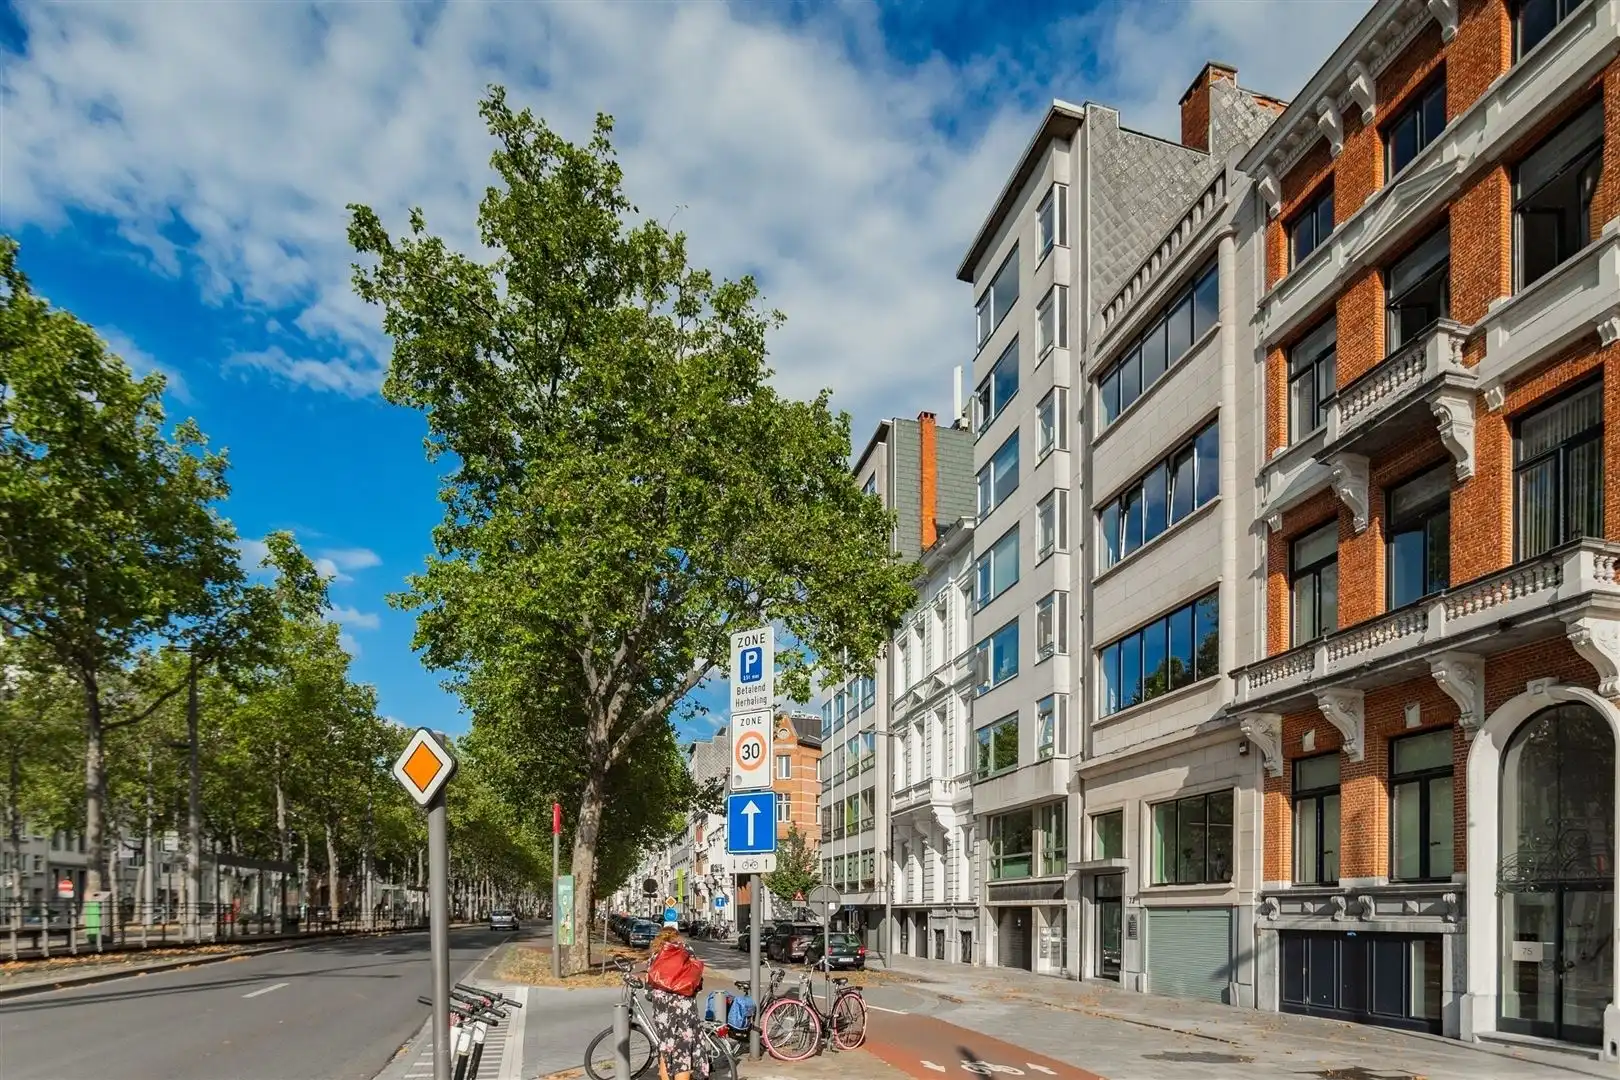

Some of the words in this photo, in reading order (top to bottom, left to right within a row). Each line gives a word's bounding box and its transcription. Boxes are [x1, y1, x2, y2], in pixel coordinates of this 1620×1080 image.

[737, 632, 766, 648] ZONE
[745, 651, 758, 674] P
[736, 683, 766, 696] Betalend
[735, 696, 767, 707] Herhaling
[740, 716, 762, 727] ZONE
[742, 743, 760, 760] 30
[1522, 947, 1533, 956] 75
